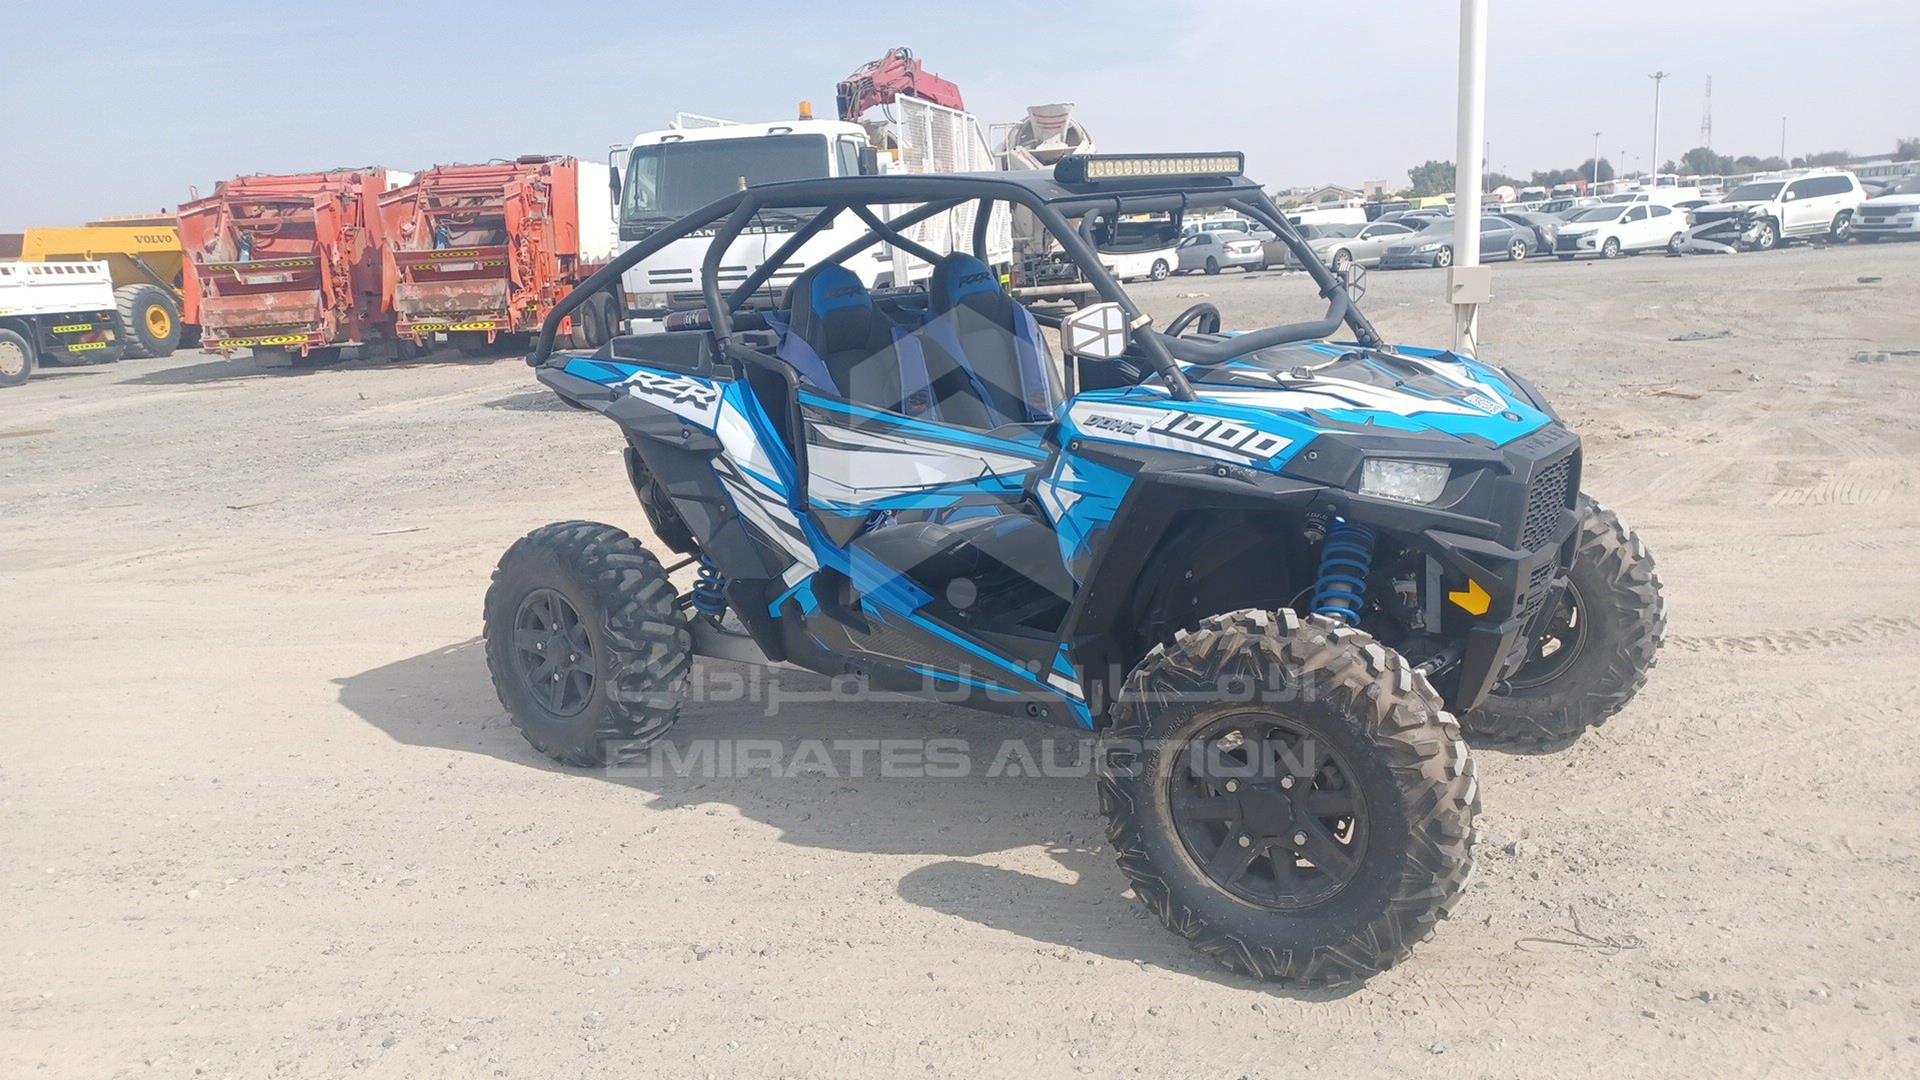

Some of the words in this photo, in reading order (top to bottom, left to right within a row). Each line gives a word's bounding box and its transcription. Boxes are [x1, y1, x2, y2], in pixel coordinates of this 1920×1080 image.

[134, 234, 172, 244] VOLVO
[958, 271, 993, 288] RZR
[612, 371, 717, 411] RZR
[1083, 414, 1144, 436] DOHC
[1149, 410, 1294, 460] 1000
